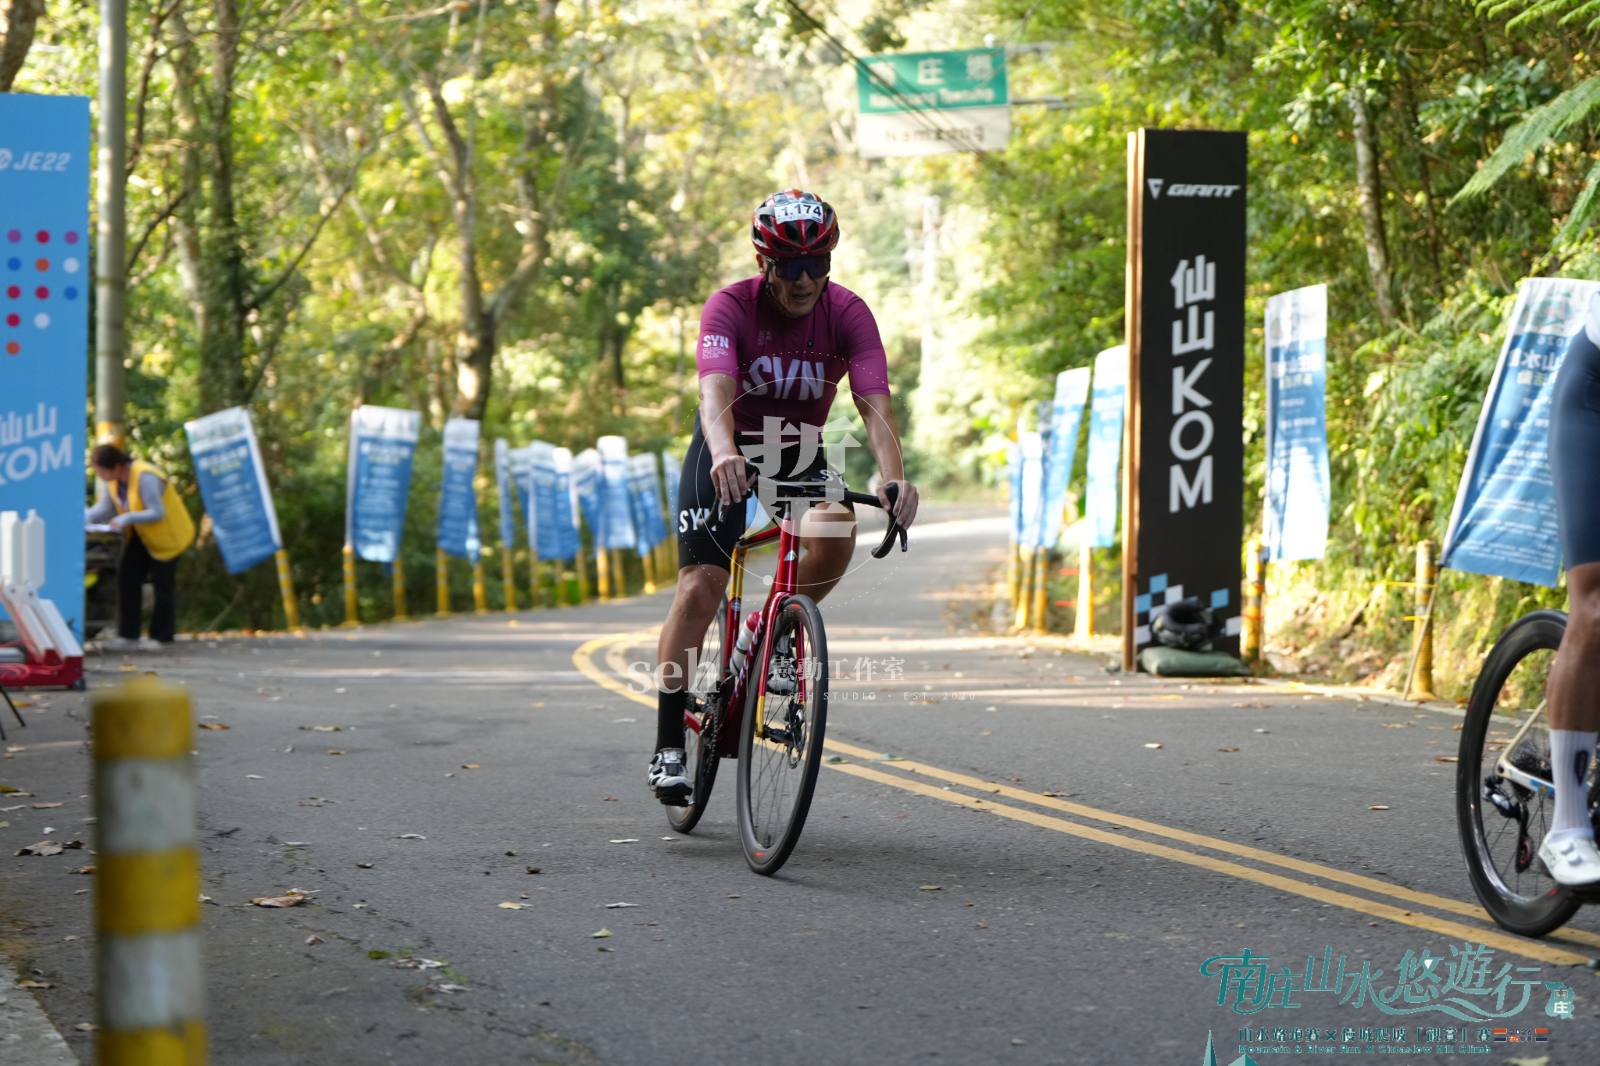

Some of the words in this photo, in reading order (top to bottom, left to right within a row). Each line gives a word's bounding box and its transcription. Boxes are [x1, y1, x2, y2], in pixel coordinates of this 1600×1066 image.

[13, 151, 72, 171] JE22
[1166, 183, 1241, 198] GIANT
[702, 334, 729, 349] SYN
[742, 356, 825, 400] SYN
[0, 432, 72, 485] OM
